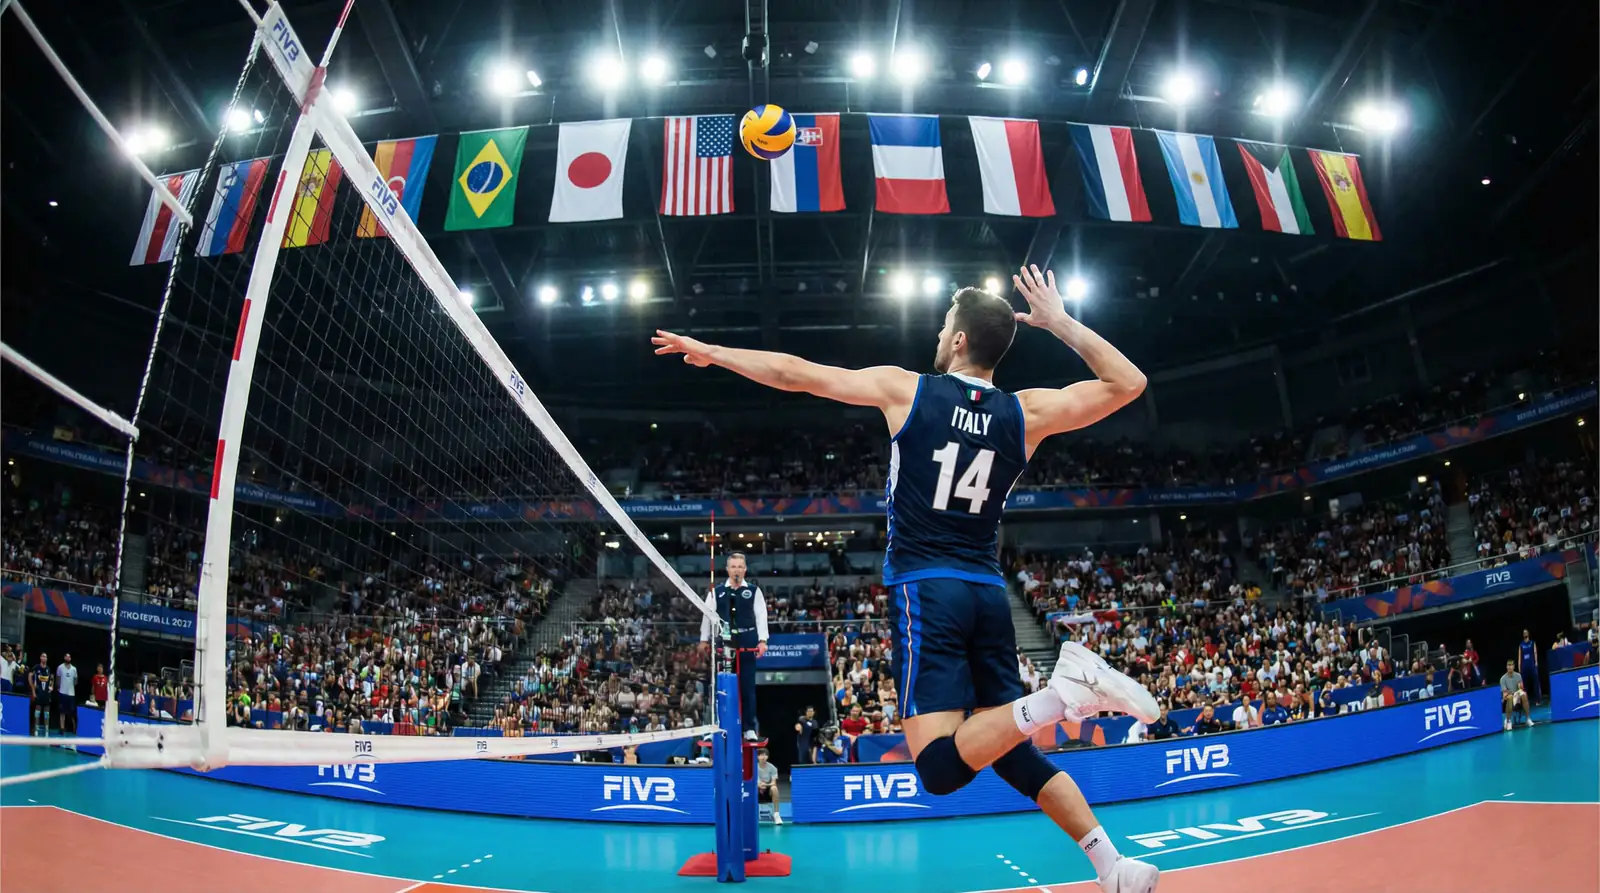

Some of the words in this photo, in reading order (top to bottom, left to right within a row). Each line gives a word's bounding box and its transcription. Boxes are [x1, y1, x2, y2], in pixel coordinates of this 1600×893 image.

[273, 18, 299, 61] FIVB
[372, 176, 397, 215] FIVB
[951, 406, 993, 436] ITALY
[932, 441, 996, 514] 14
[1486, 571, 1510, 584] FIVB
[1425, 700, 1471, 730] FIVB
[355, 741, 372, 752] FIVB
[1166, 744, 1229, 774] FIVB
[318, 762, 376, 782] FIVB
[844, 773, 918, 800] FIVB
[604, 775, 676, 801] FIVB
[196, 813, 386, 847] FIVB
[1125, 809, 1329, 848] FIVB
